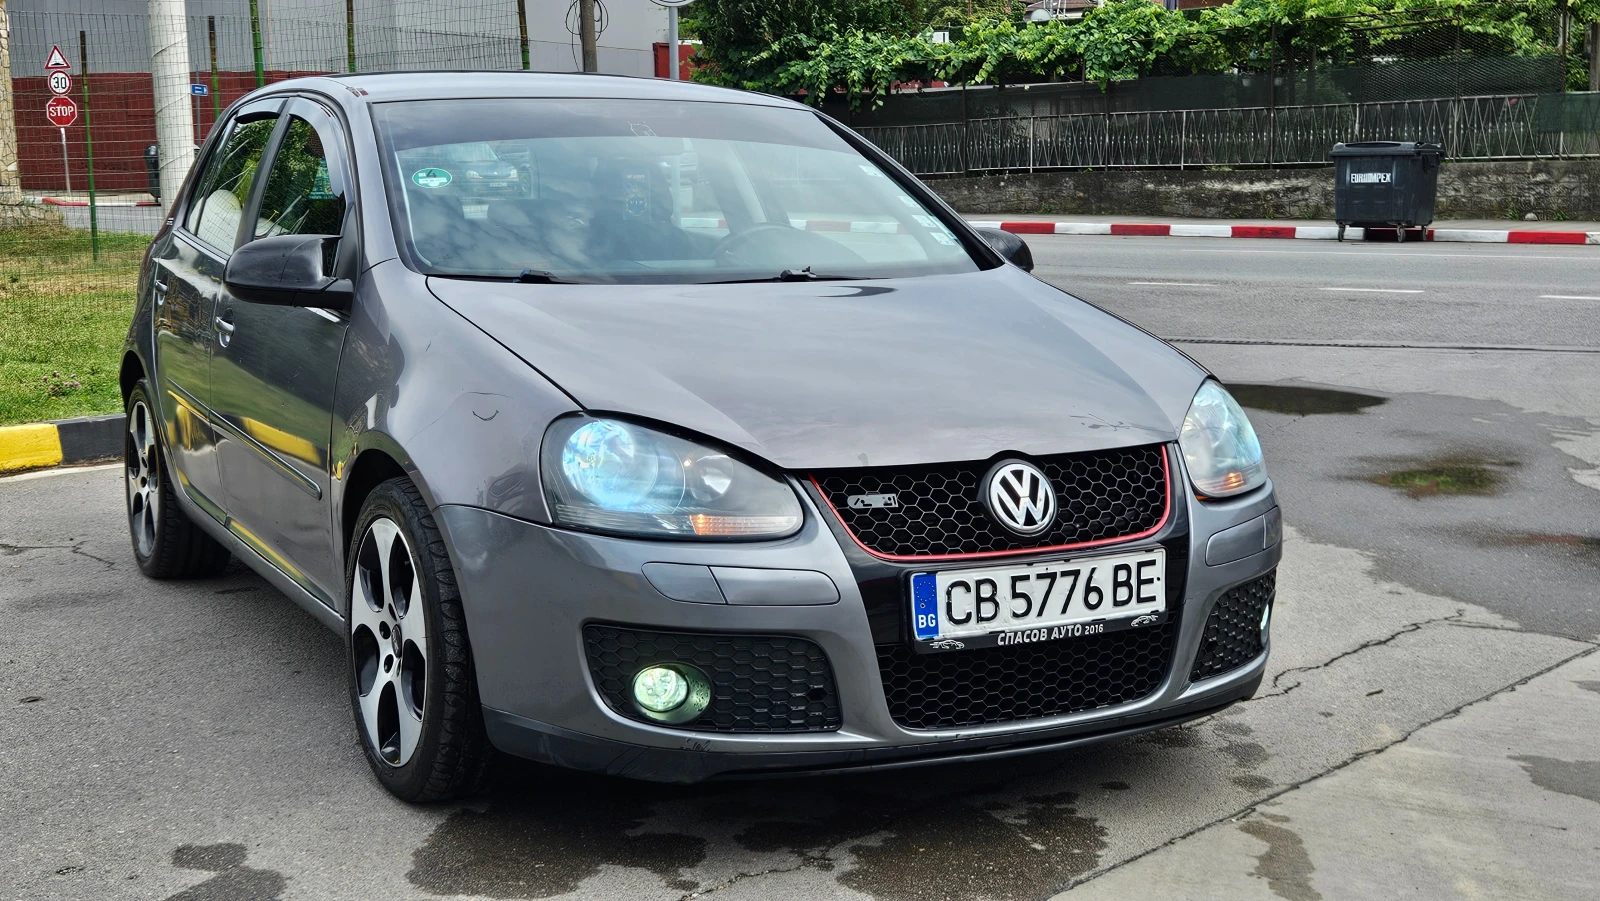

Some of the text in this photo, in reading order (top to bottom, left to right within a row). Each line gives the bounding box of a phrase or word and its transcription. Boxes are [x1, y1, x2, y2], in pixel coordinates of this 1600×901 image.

[53, 76, 67, 90] 30
[49, 105, 74, 117] STOP
[991, 463, 1054, 531] VW
[1010, 567, 1104, 618] 5776
[918, 614, 936, 629] BG
[997, 624, 1104, 646] СПАСОВ АУТО 2016
